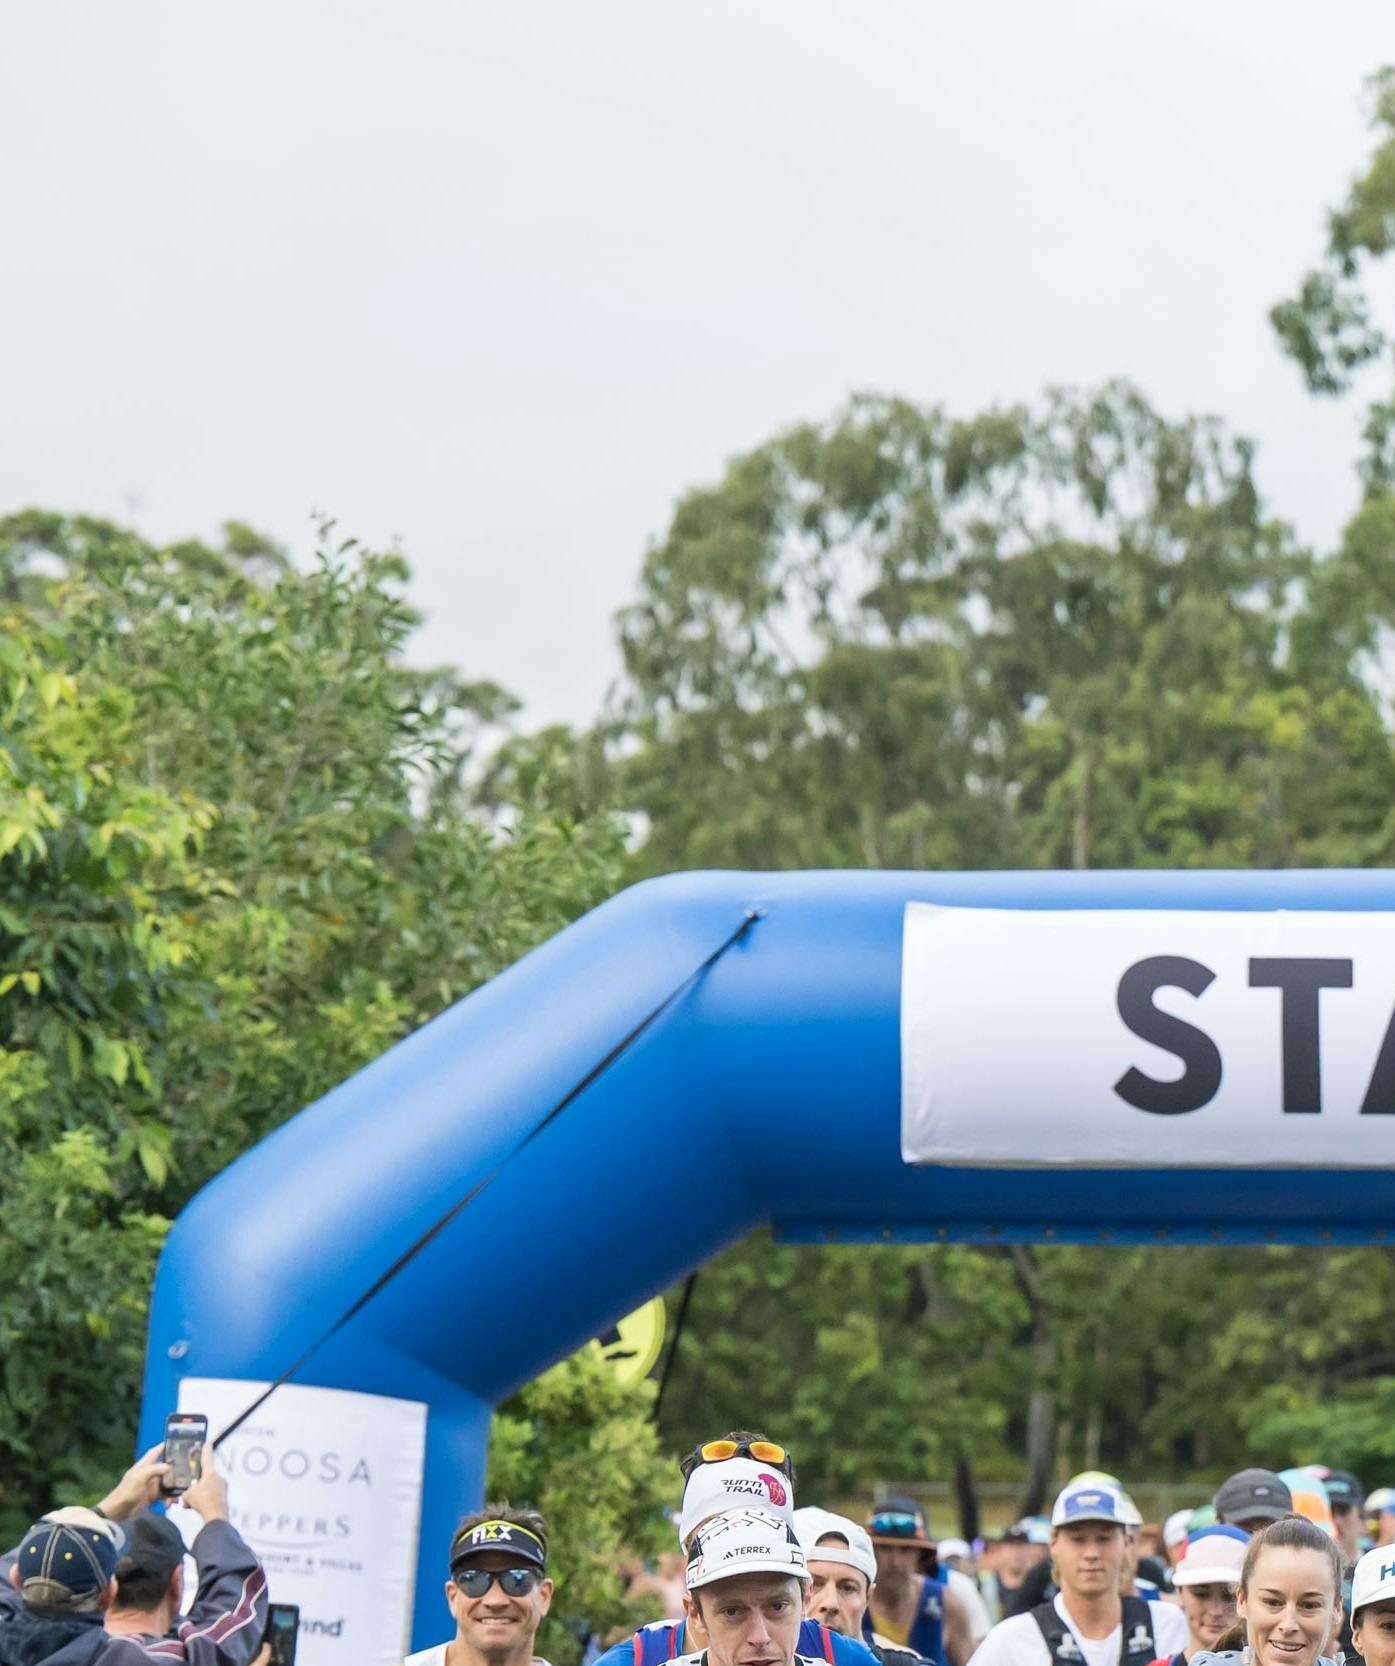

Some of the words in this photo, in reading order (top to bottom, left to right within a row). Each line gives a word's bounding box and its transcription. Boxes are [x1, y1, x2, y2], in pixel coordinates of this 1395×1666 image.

[725, 1485, 765, 1497] TRAIL
[471, 1525, 513, 1545] FIXX
[735, 1545, 771, 1556] TERREX
